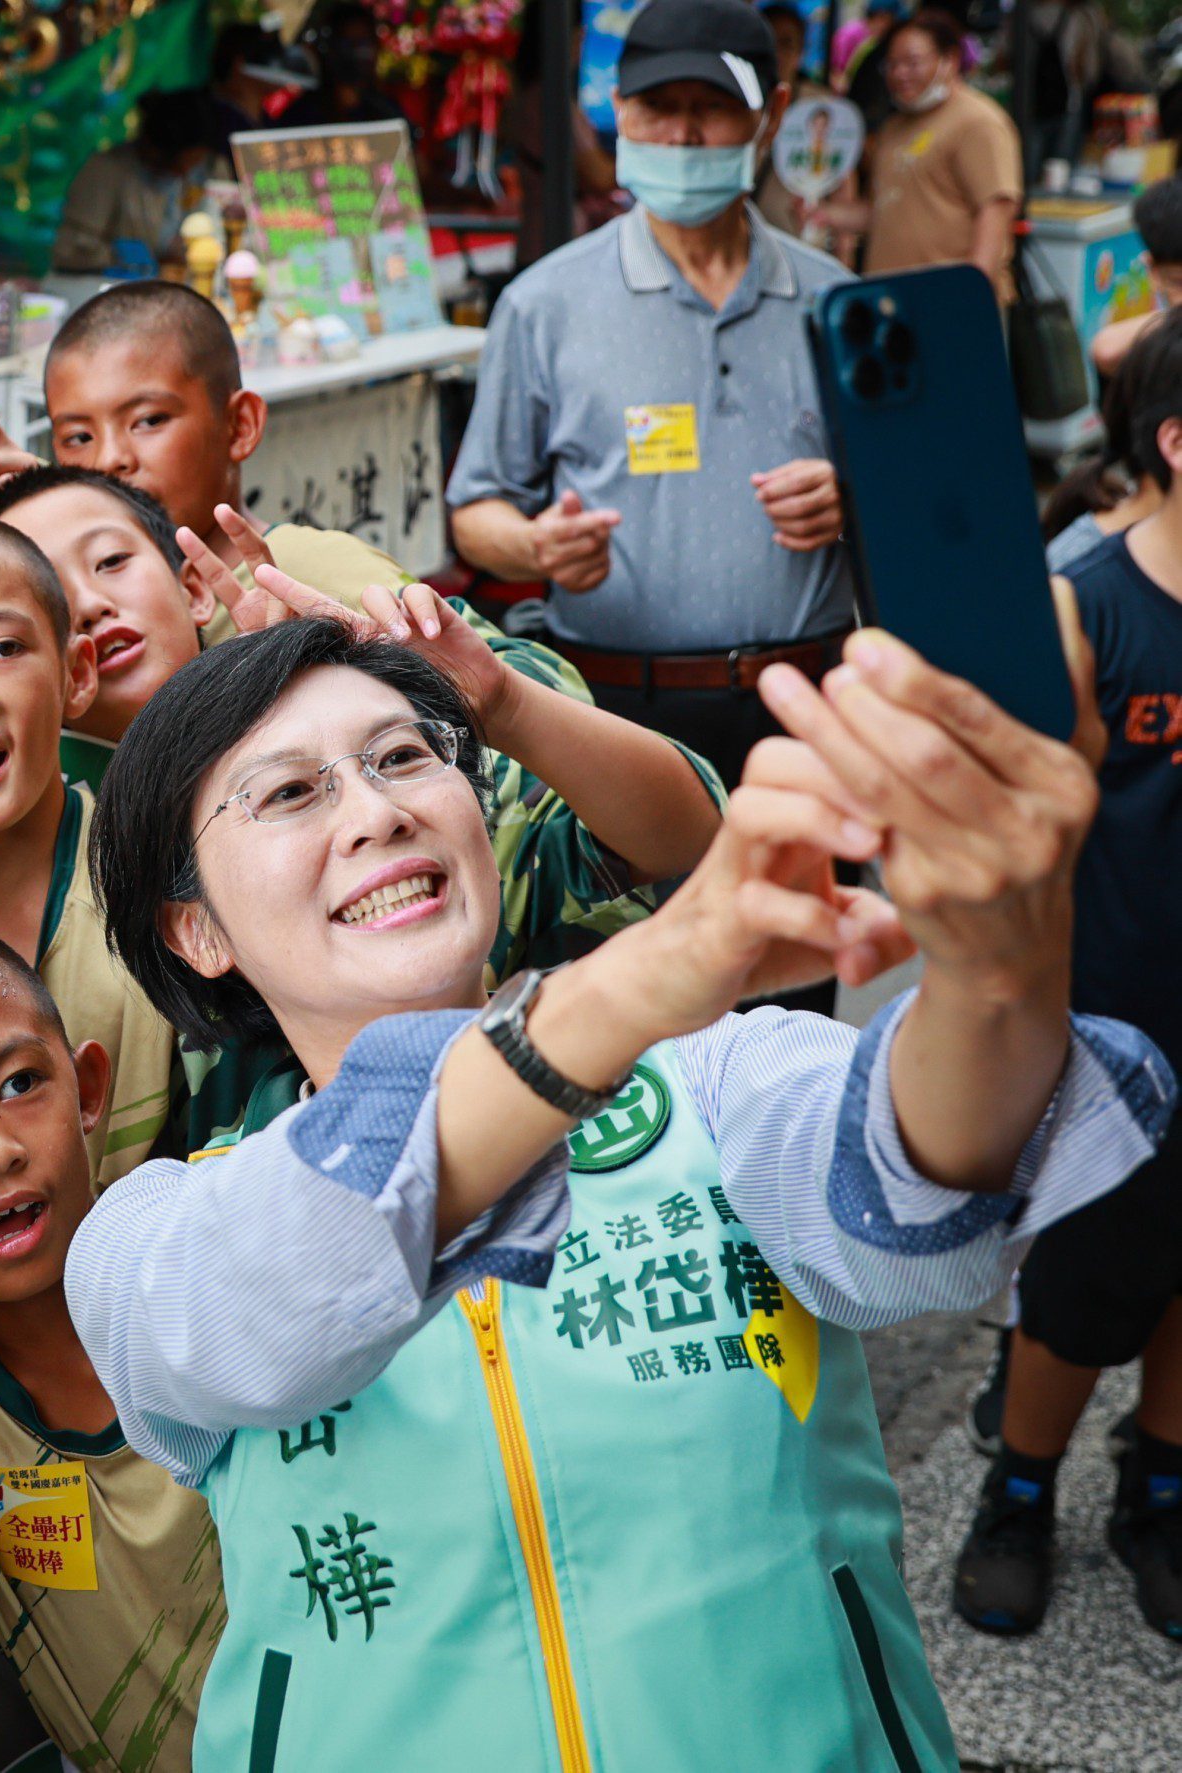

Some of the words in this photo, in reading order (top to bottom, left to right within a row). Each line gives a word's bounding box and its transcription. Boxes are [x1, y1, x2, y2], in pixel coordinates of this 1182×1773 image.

[552, 1239, 785, 1351] 林岱樺
[626, 1331, 786, 1393] 服務團隊
